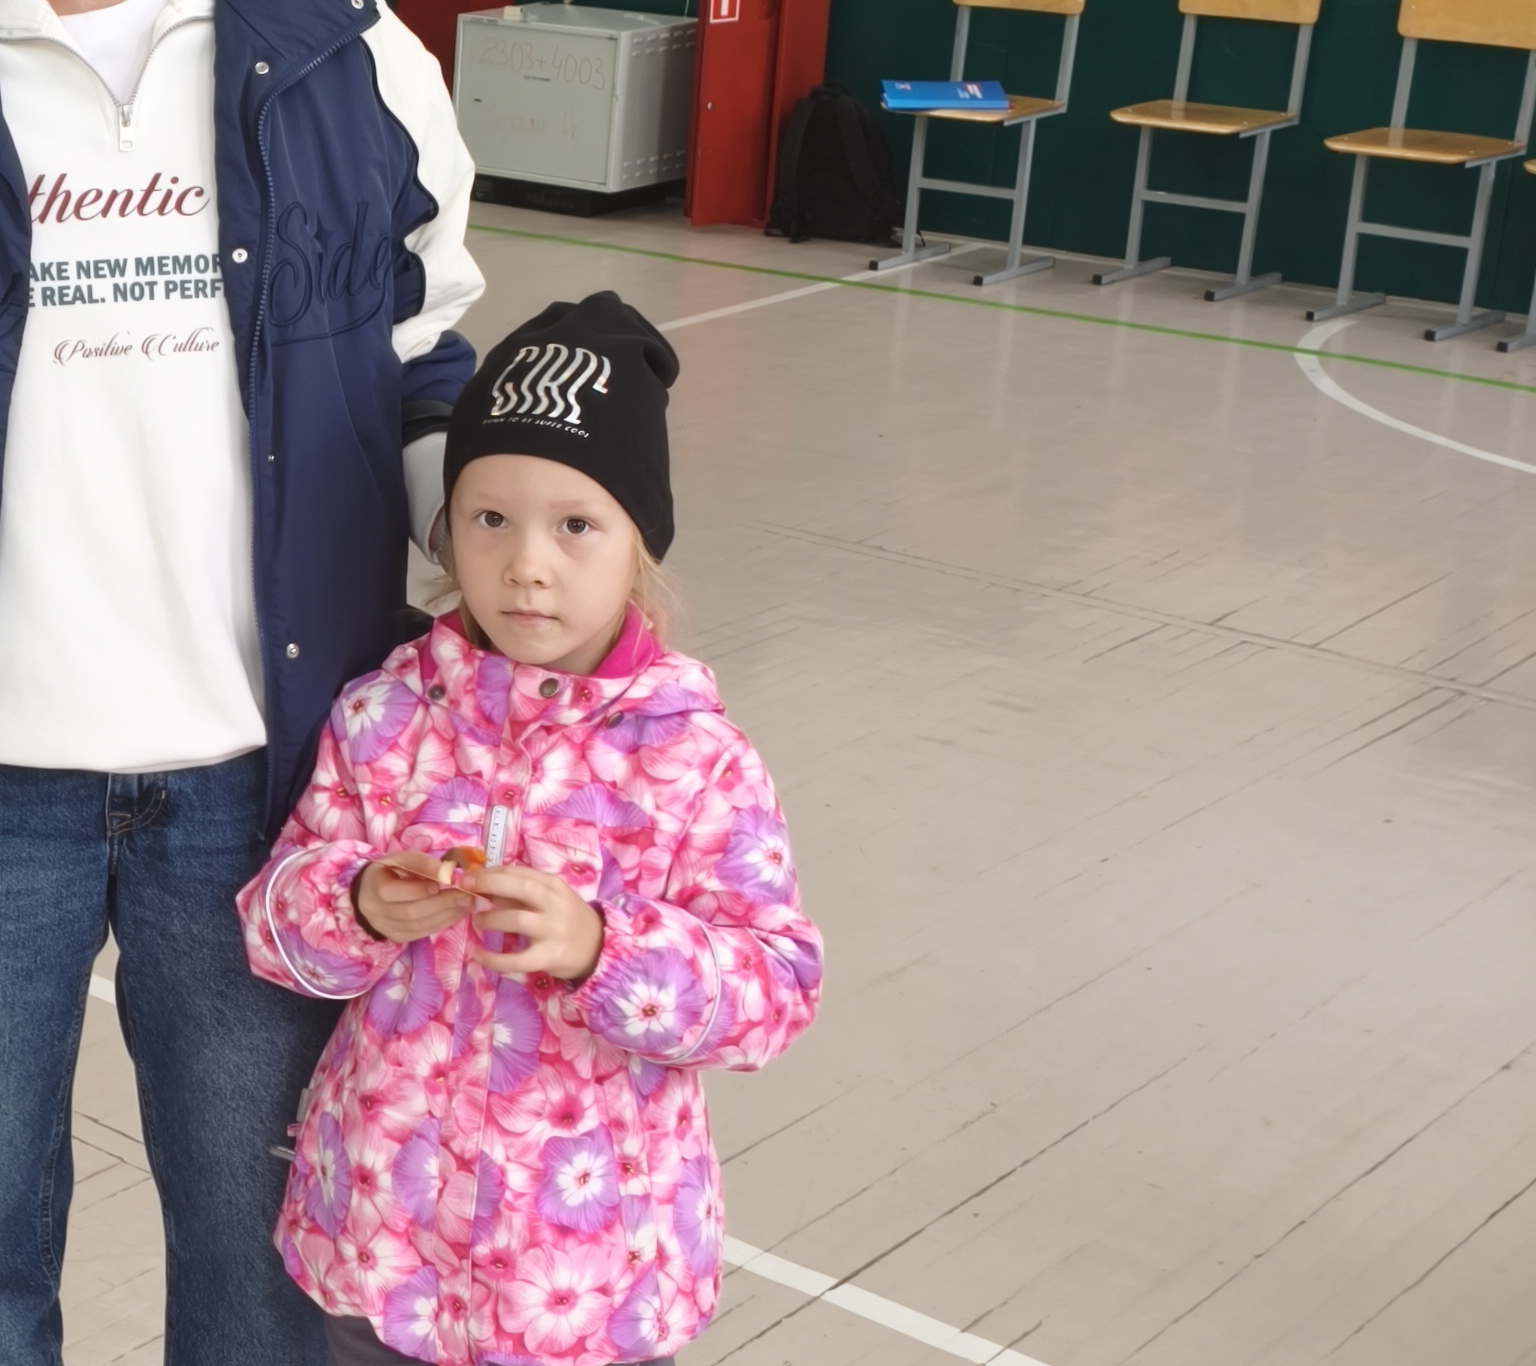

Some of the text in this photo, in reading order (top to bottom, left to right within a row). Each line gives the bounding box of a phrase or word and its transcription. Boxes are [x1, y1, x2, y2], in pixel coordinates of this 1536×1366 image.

[76, 258, 128, 280] NEW
[41, 283, 106, 307] REAL.
[112, 281, 158, 303] NOT
[52, 327, 220, 366] Positive Culture
